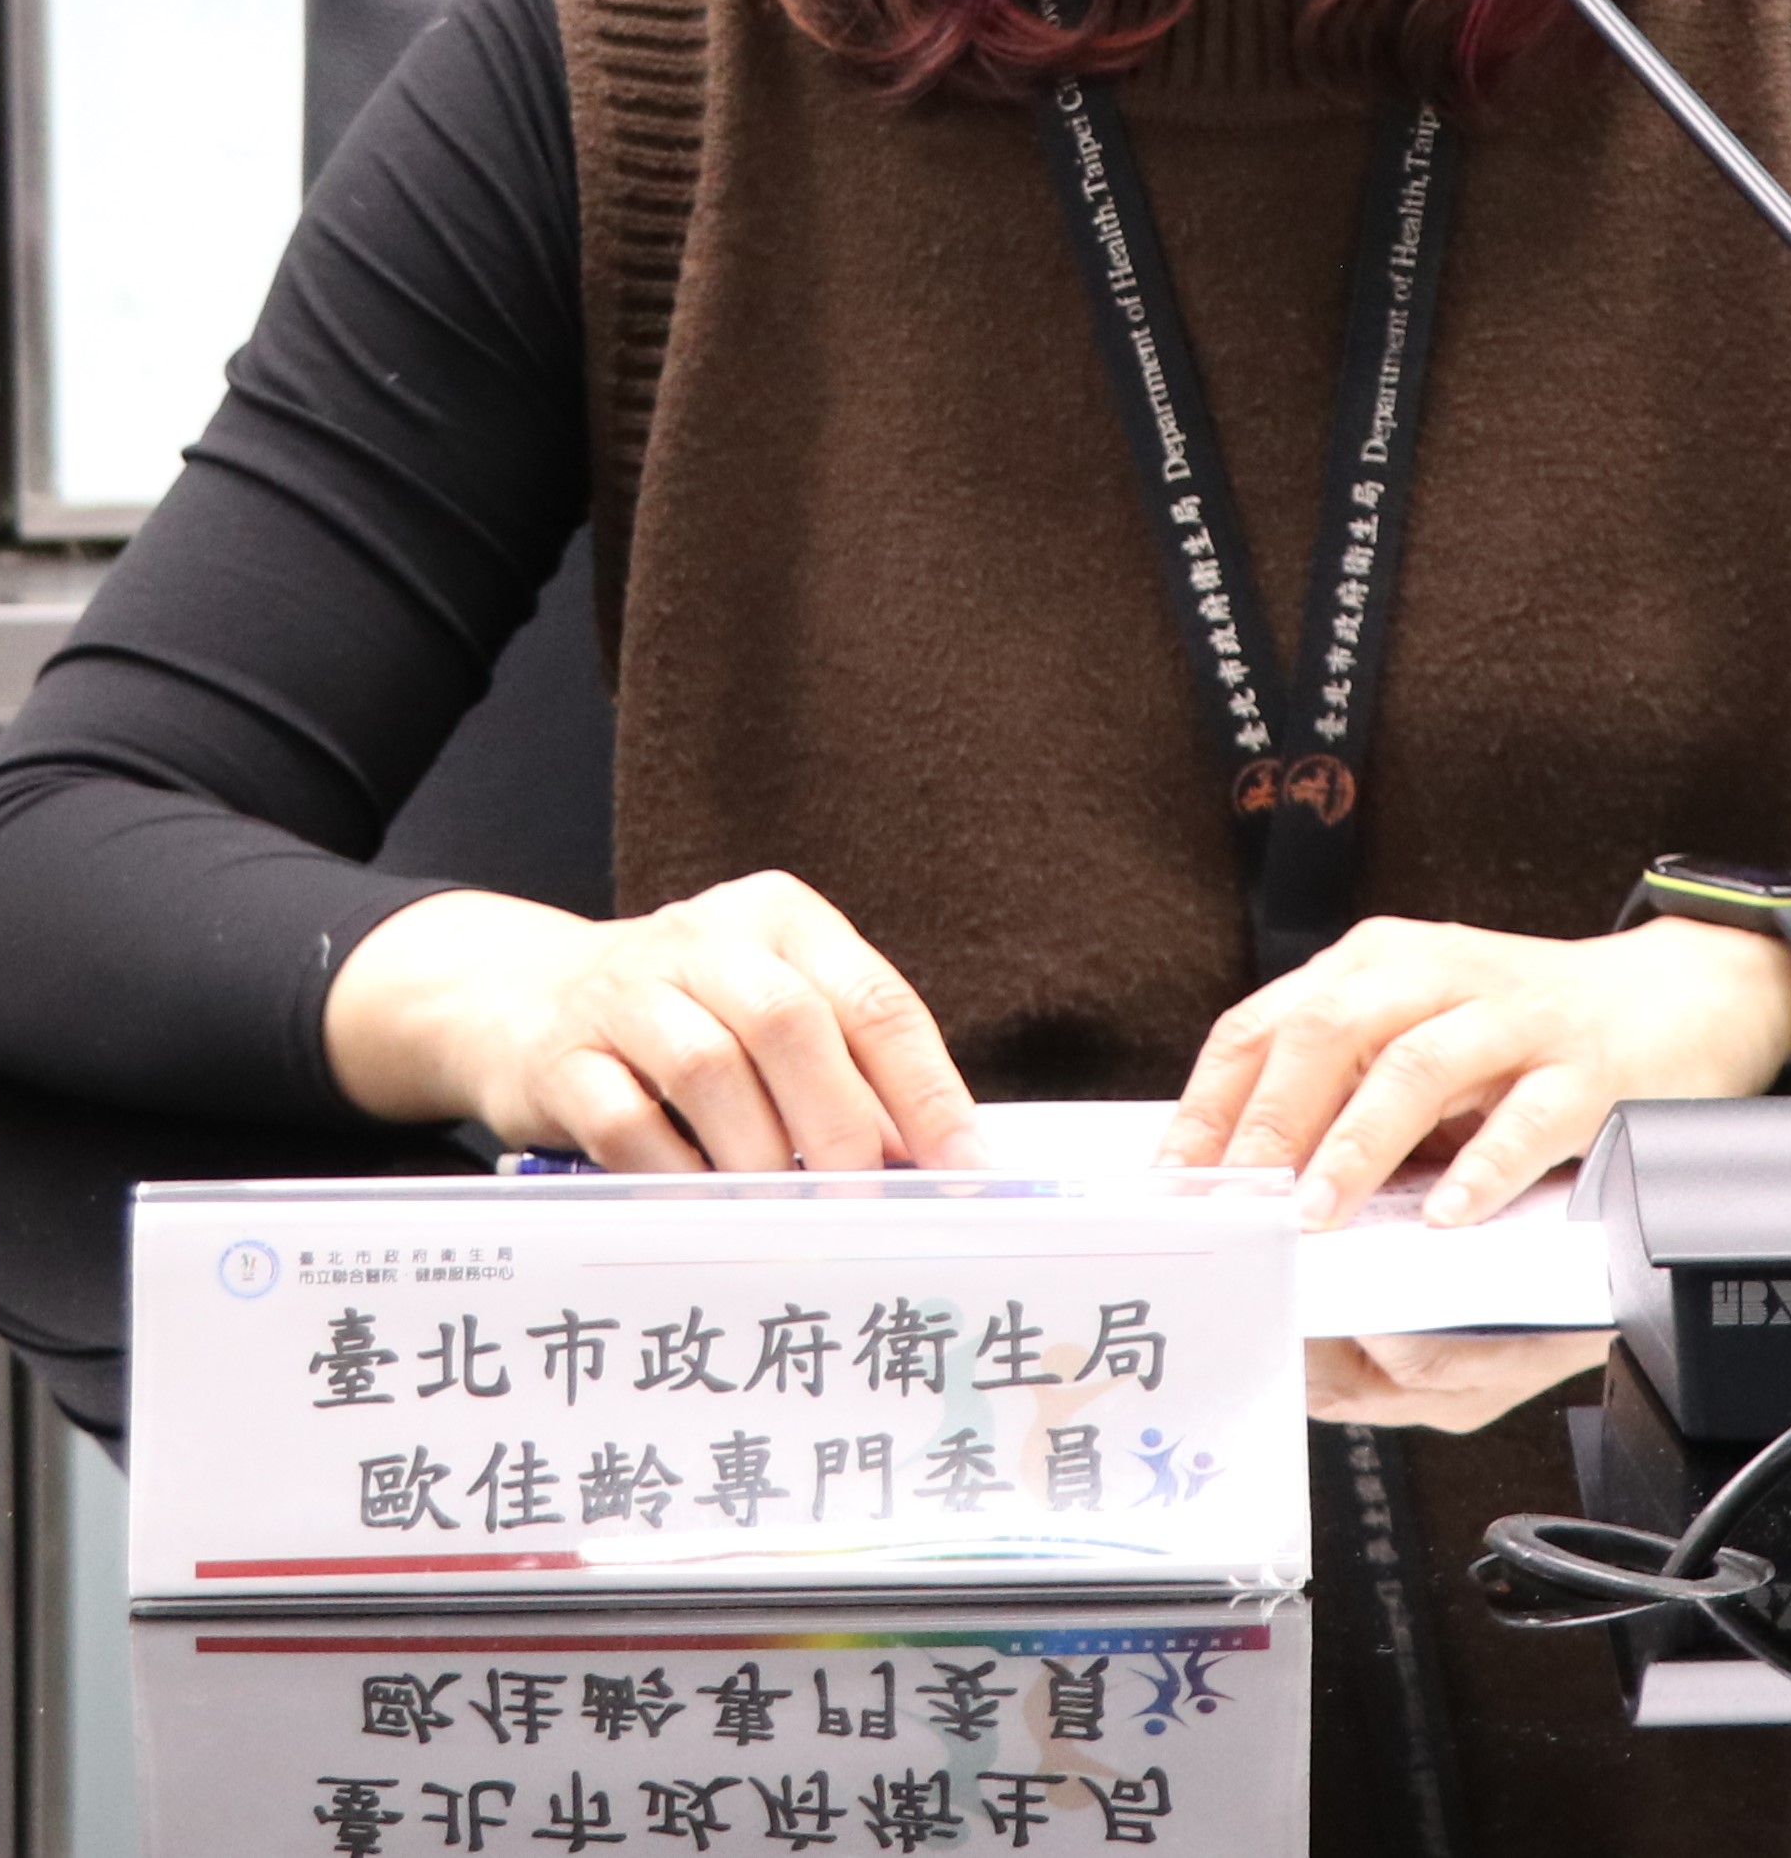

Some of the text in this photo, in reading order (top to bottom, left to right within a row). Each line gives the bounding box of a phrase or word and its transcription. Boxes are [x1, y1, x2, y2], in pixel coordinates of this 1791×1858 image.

[1116, 294, 1146, 322] of
[1130, 328, 1192, 483] Department
[1360, 309, 1410, 463] Department
[1389, 272, 1414, 302] of
[308, 1297, 1169, 1411] 臺北市政府衛生局
[358, 1425, 1105, 1535] 歐佳齡專門委員
